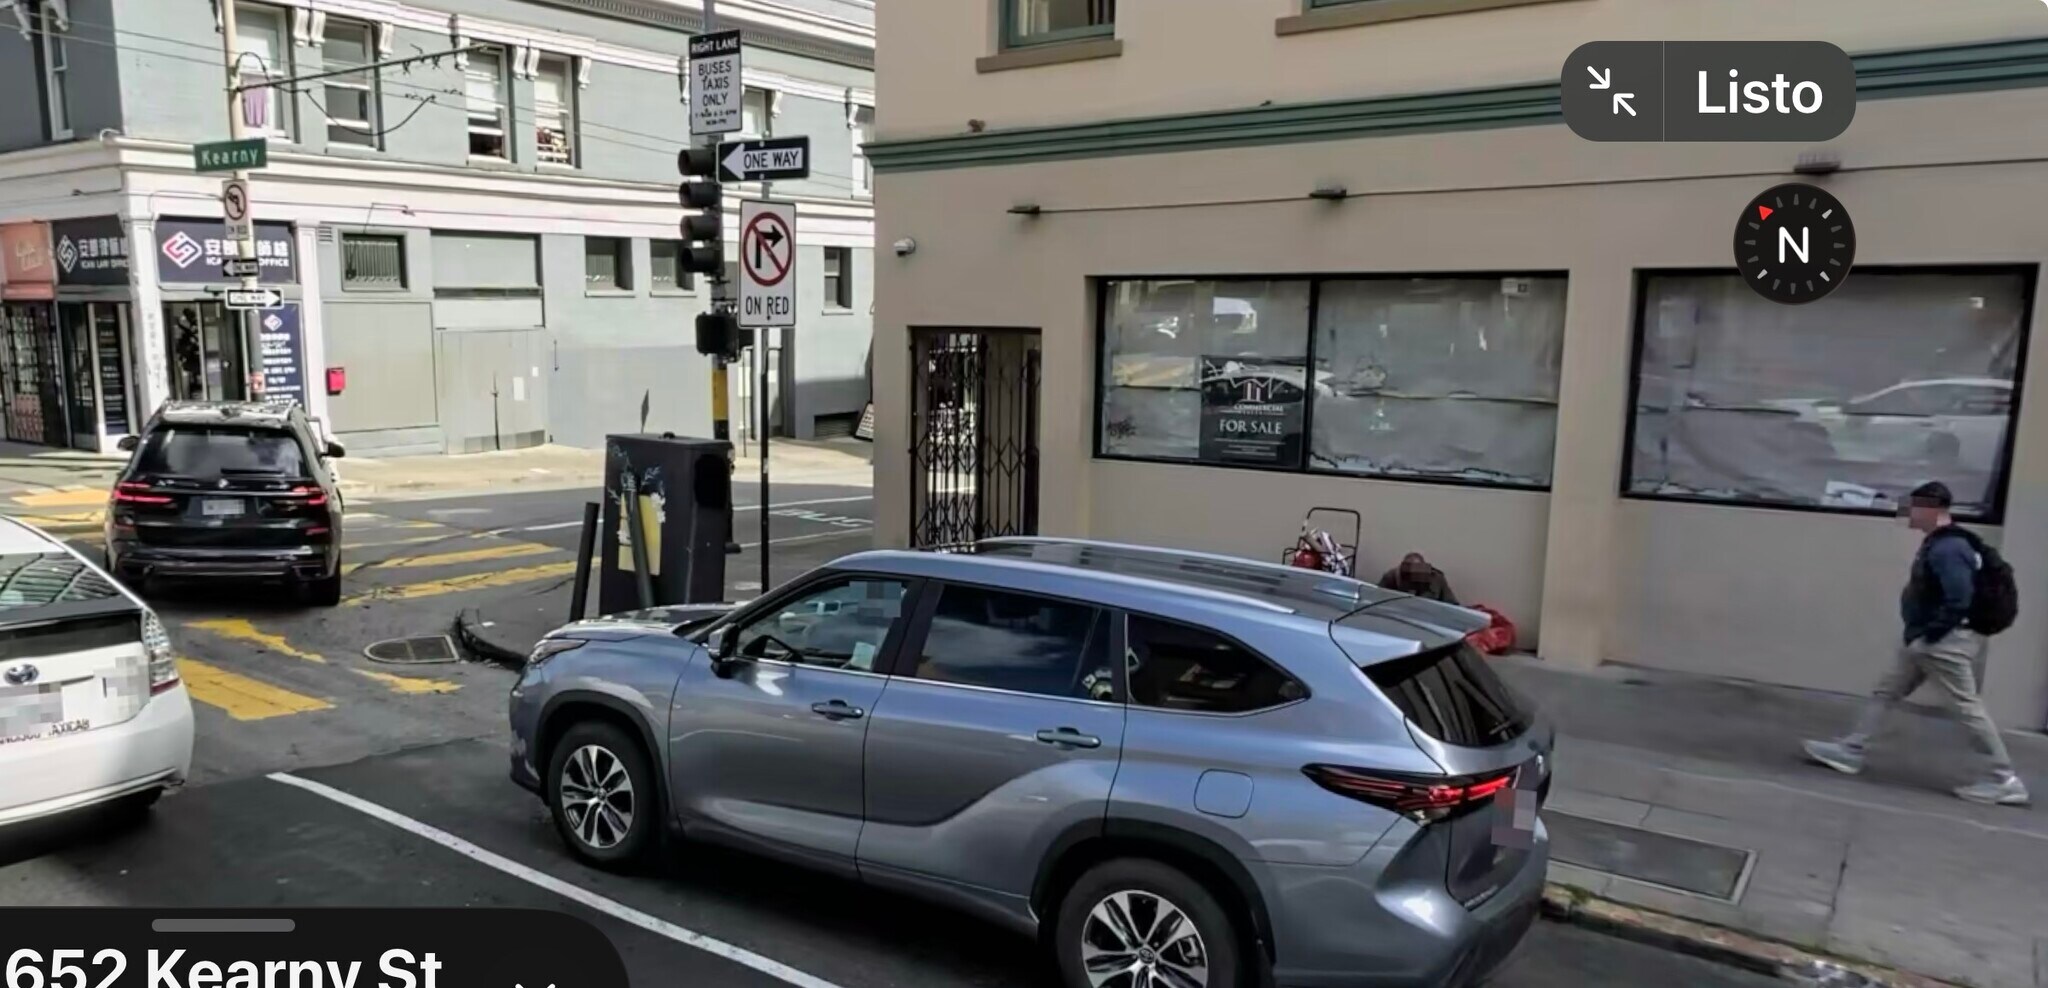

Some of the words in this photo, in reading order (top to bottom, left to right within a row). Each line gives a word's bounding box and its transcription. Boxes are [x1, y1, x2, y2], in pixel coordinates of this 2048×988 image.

[691, 41, 714, 53] RIGHT
[716, 37, 738, 50] LANE
[698, 60, 732, 76] BUSES
[703, 76, 730, 91] TAXIS
[702, 92, 728, 107] ONLY
[201, 149, 258, 166] Kearny
[743, 152, 769, 170] ONE
[772, 150, 799, 168] WAY
[745, 296, 762, 316] ON
[766, 296, 789, 315] RED
[1220, 419, 1247, 433] FOR
[1251, 420, 1282, 435] SALE
